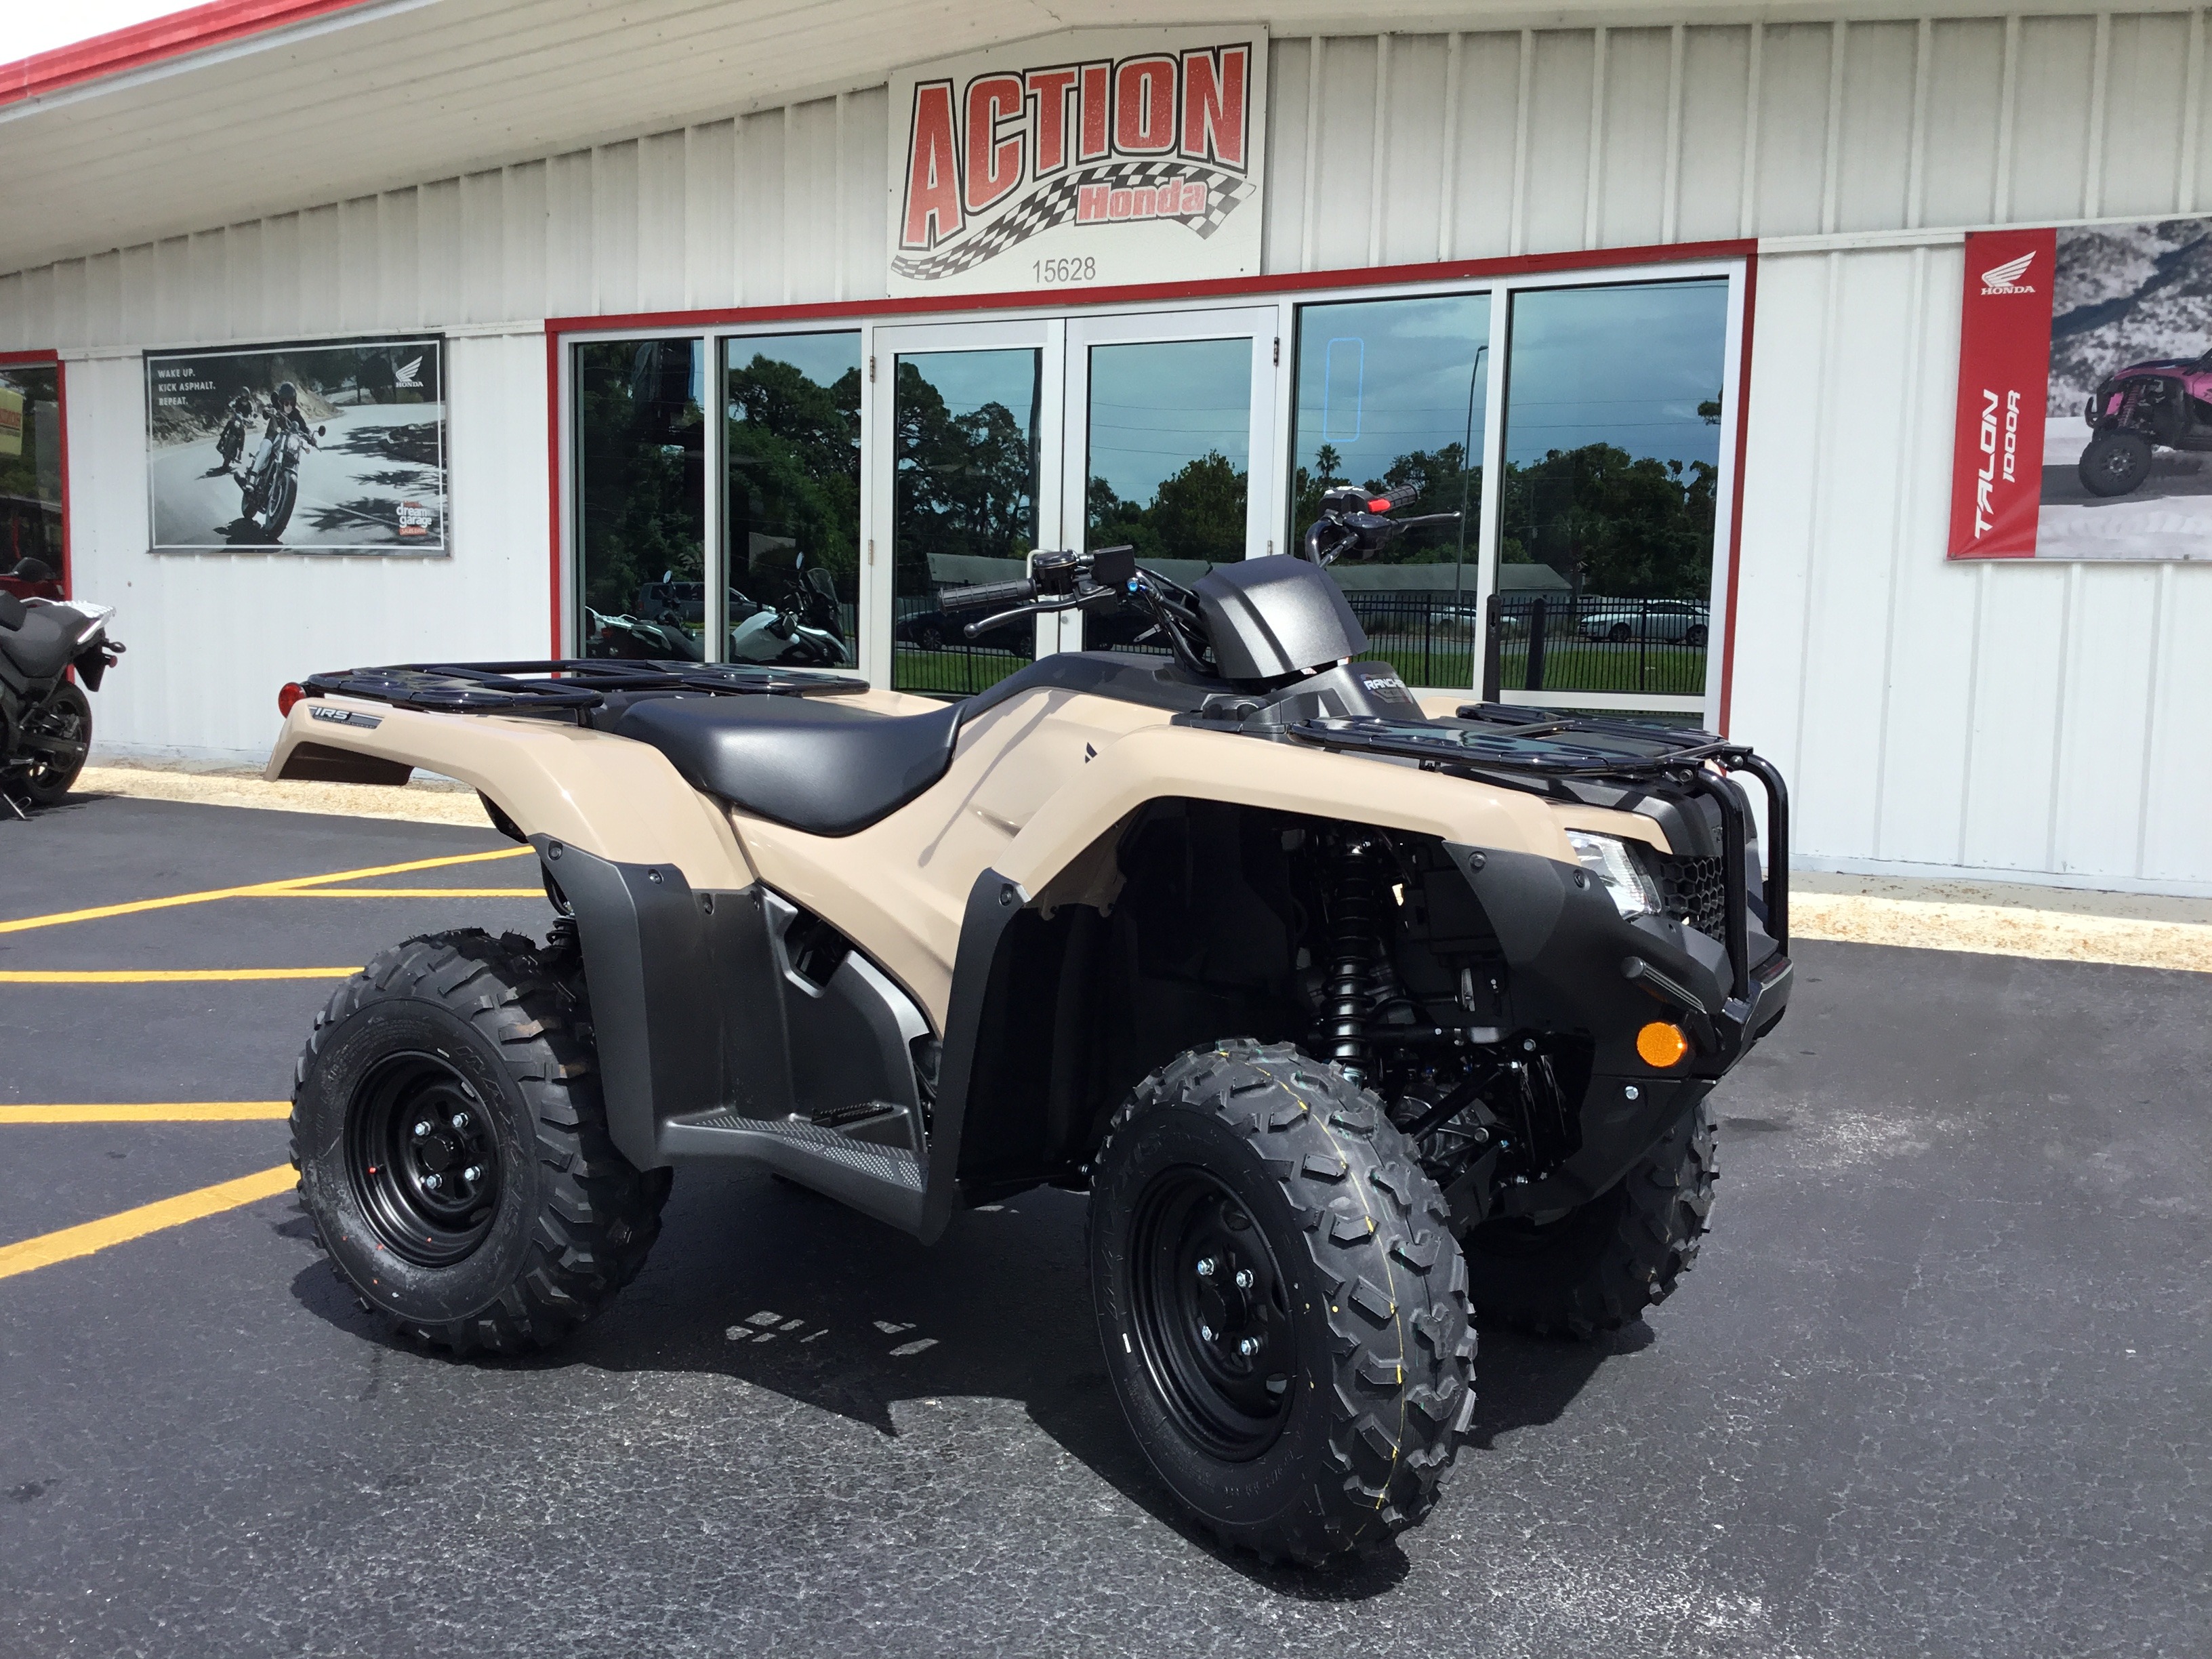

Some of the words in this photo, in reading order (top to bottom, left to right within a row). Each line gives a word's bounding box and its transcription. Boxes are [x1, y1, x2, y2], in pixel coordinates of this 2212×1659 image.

[899, 41, 1252, 251] ACTION
[1076, 176, 1208, 224] Honda
[1033, 256, 1096, 283] 15628
[1980, 285, 2036, 295] HONDA
[157, 369, 180, 378] WAKE
[182, 368, 196, 377] UP.
[158, 383, 177, 392] KICK
[179, 381, 216, 392] ASPHALT.
[159, 396, 188, 406] REPEAT.
[2003, 390, 2020, 483] 1000R
[1974, 388, 1999, 539] TALON
[396, 502, 428, 516] dream
[399, 516, 432, 529] garage
[1364, 678, 1406, 691] RANCHE
[314, 707, 350, 720] IRS
